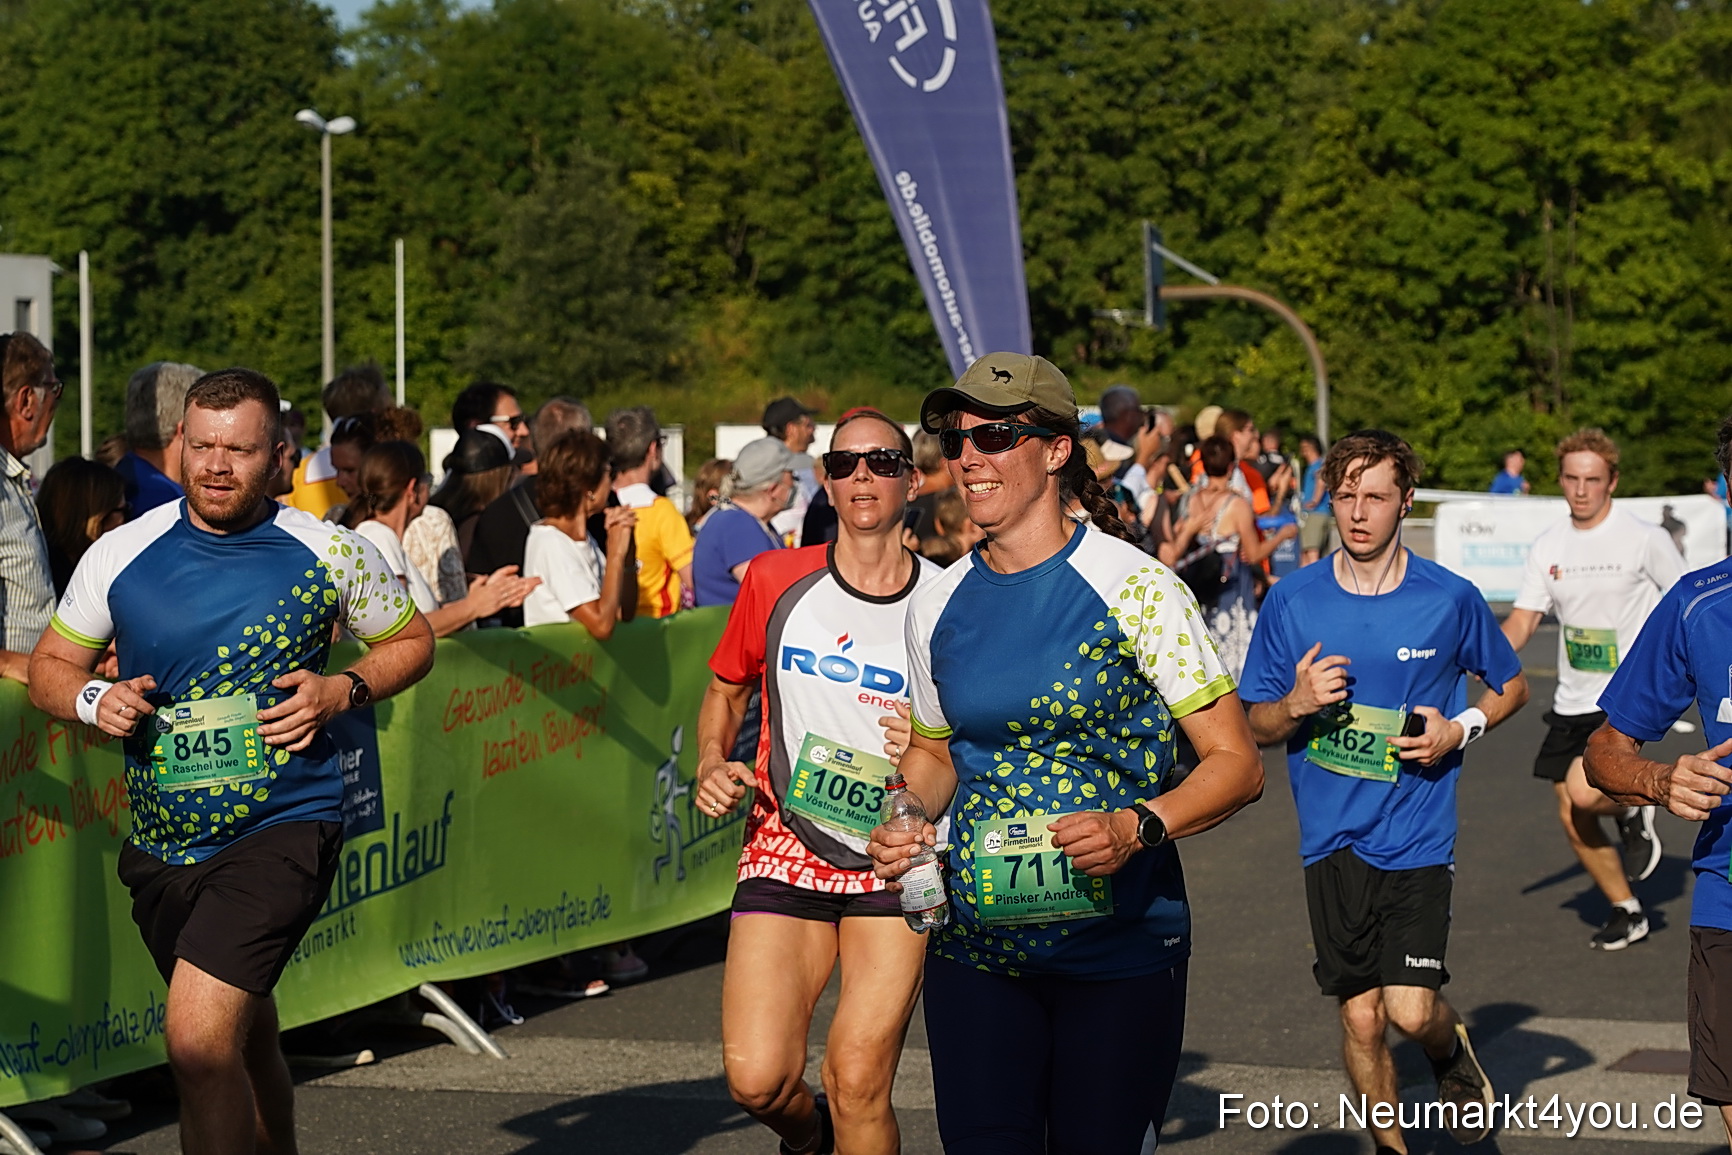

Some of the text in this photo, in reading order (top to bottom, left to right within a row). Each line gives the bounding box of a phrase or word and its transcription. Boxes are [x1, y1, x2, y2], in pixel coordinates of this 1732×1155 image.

[1706, 573, 1729, 585] JAKO
[1411, 648, 1437, 659] Berger
[443, 652, 593, 733] Gesunde Firmen
[173, 728, 232, 761] 845
[243, 728, 258, 768] 2022
[482, 718, 542, 779] laufen
[1327, 729, 1376, 755] 462
[172, 758, 239, 775] Raschel Uwe
[1351, 755, 1384, 767] Manuel
[1383, 742, 1396, 772] 202
[793, 770, 810, 799] RUN
[813, 767, 885, 813] 1063
[805, 792, 844, 815] Vöstner
[845, 807, 877, 827] Martin
[1003, 834, 1043, 847] Firmenlauf
[1018, 841, 1043, 850] neumarkt
[1004, 851, 1070, 889] 711
[981, 869, 995, 905] RUN
[995, 888, 1090, 906] Pinsker Andrea
